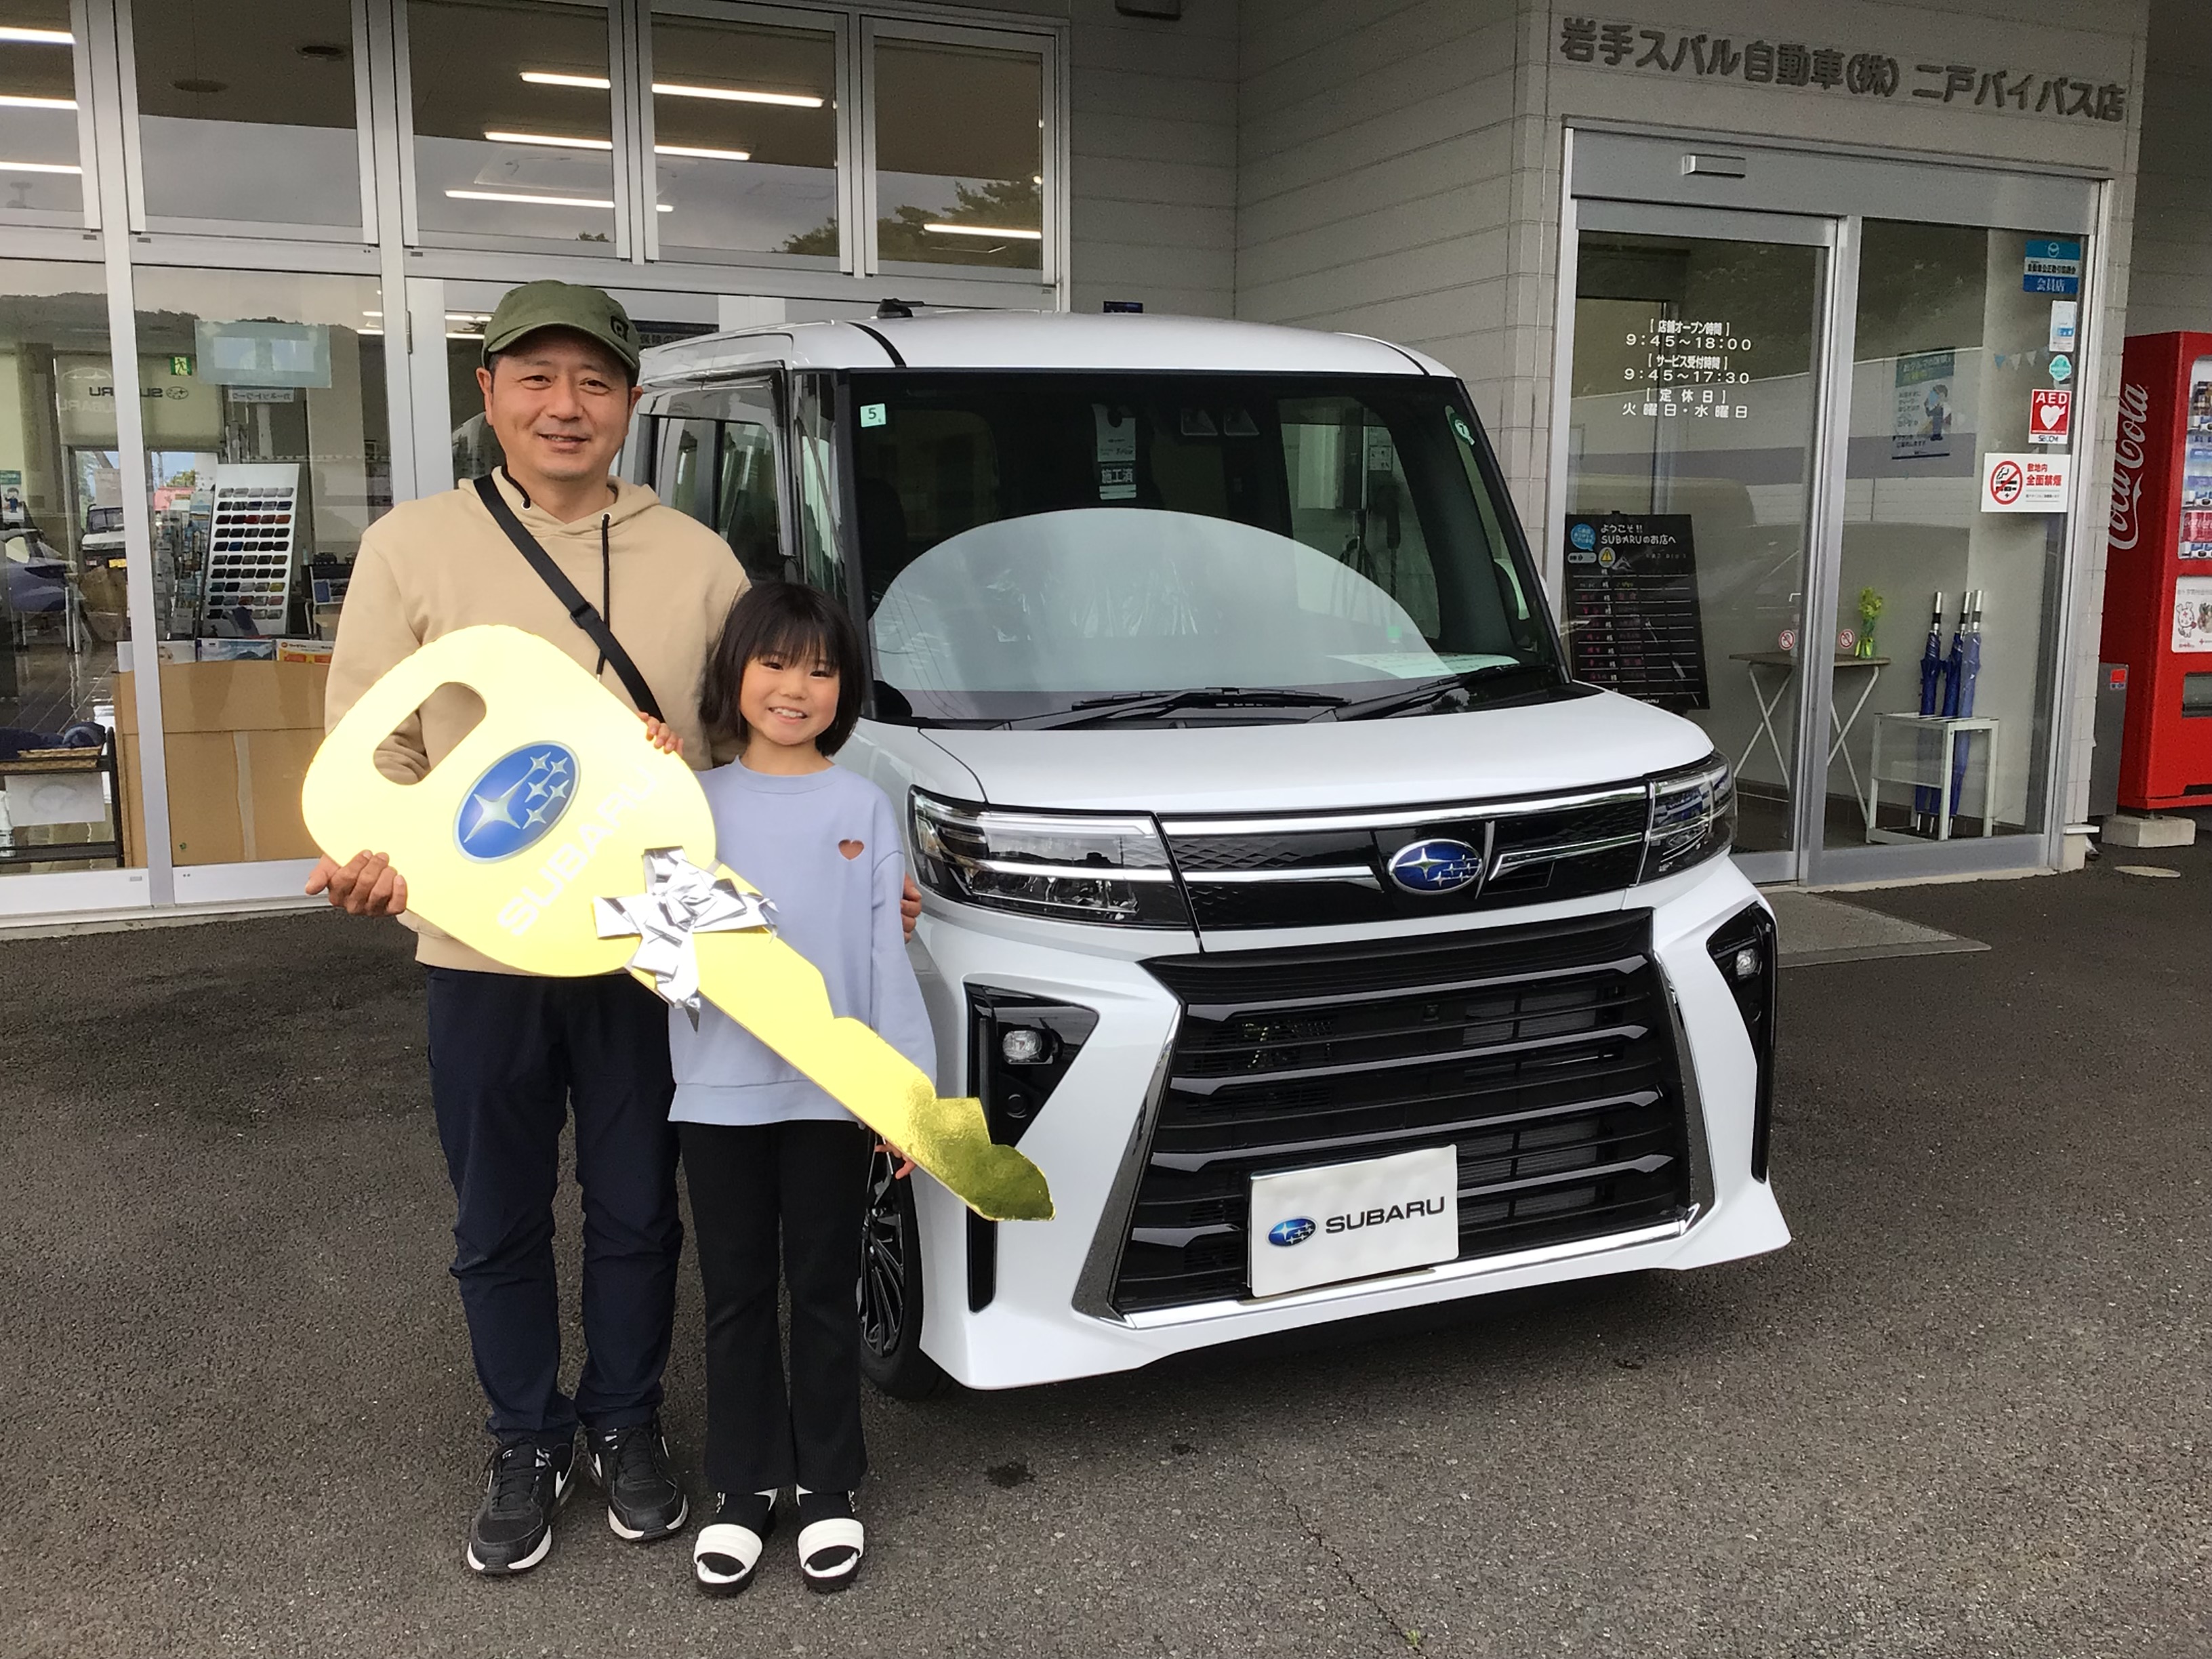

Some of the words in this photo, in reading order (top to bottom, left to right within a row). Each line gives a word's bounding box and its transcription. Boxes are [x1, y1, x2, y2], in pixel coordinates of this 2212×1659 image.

[1912, 65, 2127, 122] 二戸バイパス店
[2035, 392, 2068, 405] AED
[868, 407, 877, 419] 5
[1622, 402, 1748, 419] 火曜日・水曜日
[2026, 474, 2062, 486] 全面禁煙
[497, 766, 658, 936] SUBARU
[1326, 1196, 1445, 1234] SUBARU
